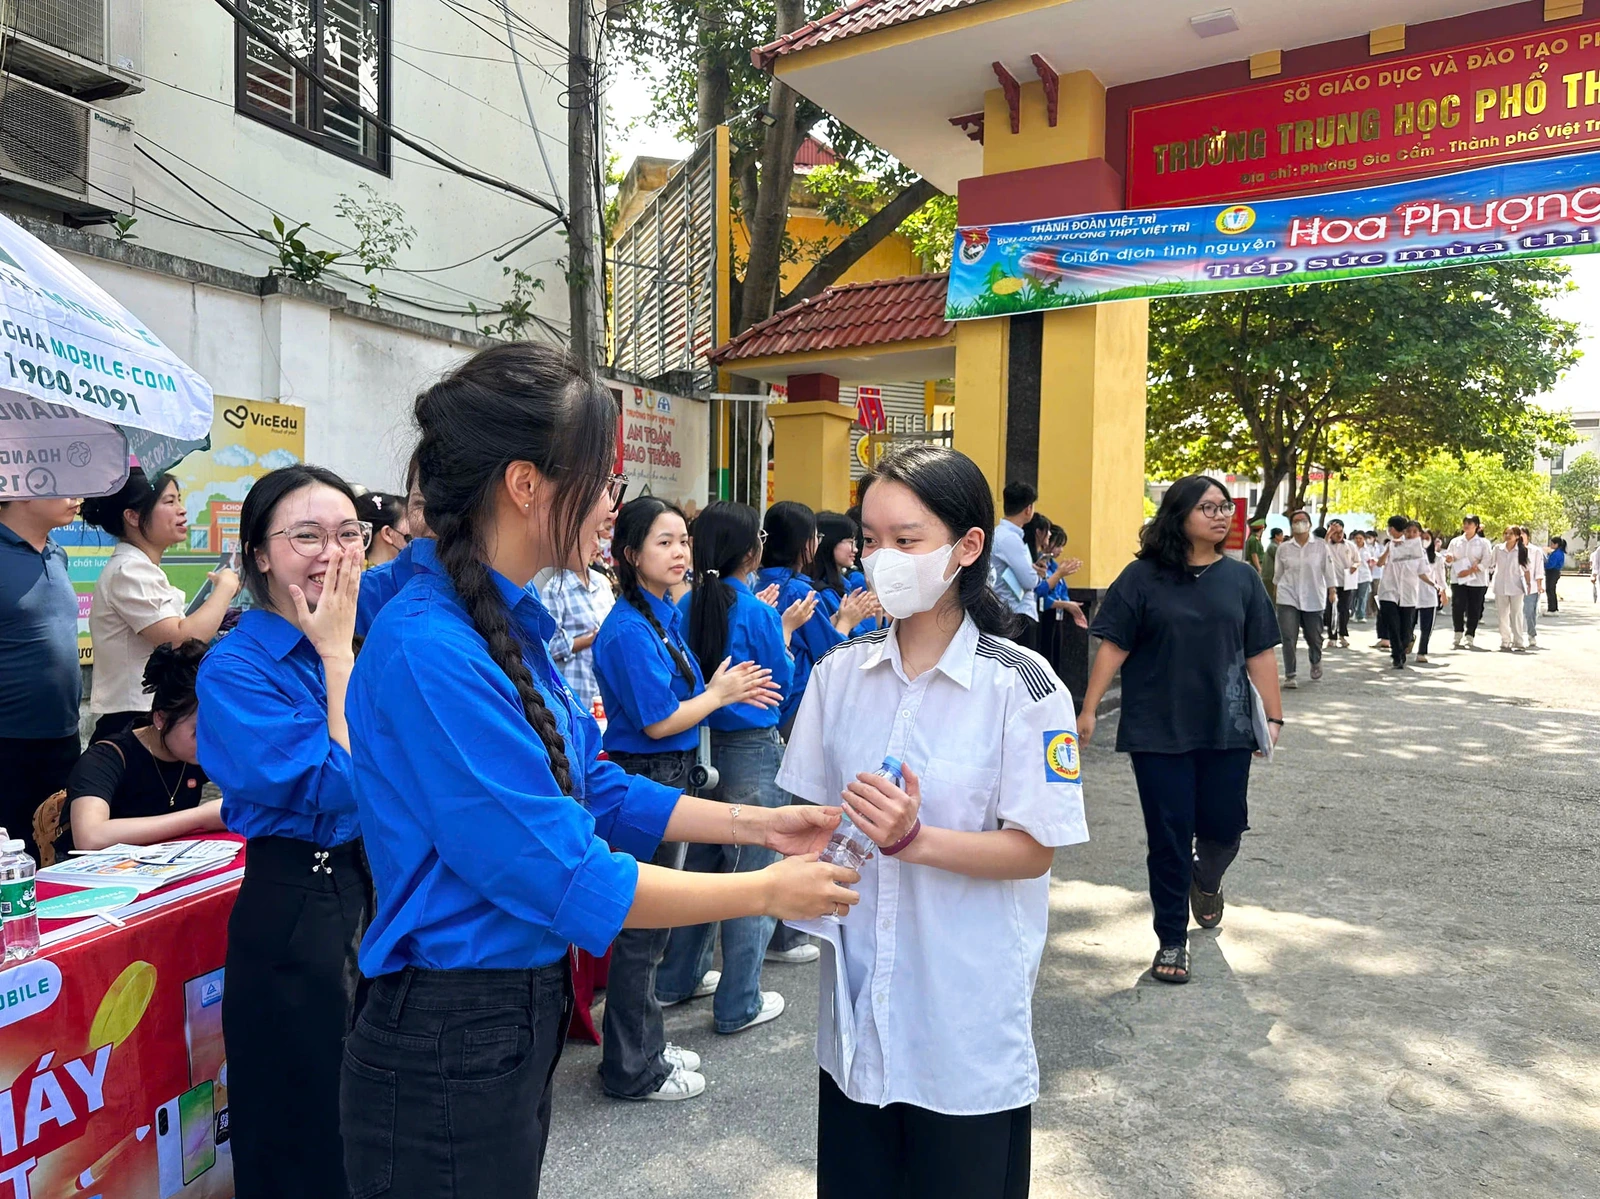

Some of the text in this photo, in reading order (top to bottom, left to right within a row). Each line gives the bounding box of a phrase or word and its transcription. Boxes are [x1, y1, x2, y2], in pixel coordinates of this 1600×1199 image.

[1283, 82, 1311, 104] SỞ
[1318, 73, 1370, 98] GIÁO
[1378, 66, 1422, 88] DỤC
[1430, 54, 1459, 78] VÀ
[1466, 47, 1515, 70] ĐÀO
[1522, 38, 1569, 61] TẠO
[1153, 125, 1267, 175] TRƯỜNG
[1277, 107, 1380, 155] TRUNG
[1394, 94, 1461, 141] HỌC
[1474, 62, 1549, 124] PHỔ
[1240, 171, 1264, 185] Địa
[1301, 158, 1357, 175] Phường
[1362, 152, 1390, 166] Gia
[1396, 141, 1435, 161] Cẩm
[1449, 134, 1500, 153] Thành
[1505, 123, 1543, 147] phố
[1544, 120, 1581, 140] Việt
[1030, 213, 1157, 234] THÀNH ĐOÀN VIỆT TRÌ
[1108, 227, 1138, 238] THPT
[1141, 224, 1168, 237] VIỆT
[1169, 222, 1190, 234] TRÌ
[1290, 216, 1388, 247] Hoa
[1061, 238, 1277, 263] Chiến dịch tình nguyện
[1206, 226, 1593, 278] Tiếp sức mùa thi
[4, 352, 142, 415] 1900.2091
[250, 412, 297, 429] VicEdu
[627, 423, 672, 447] AN TOÀN
[647, 445, 681, 468] THÔNG
